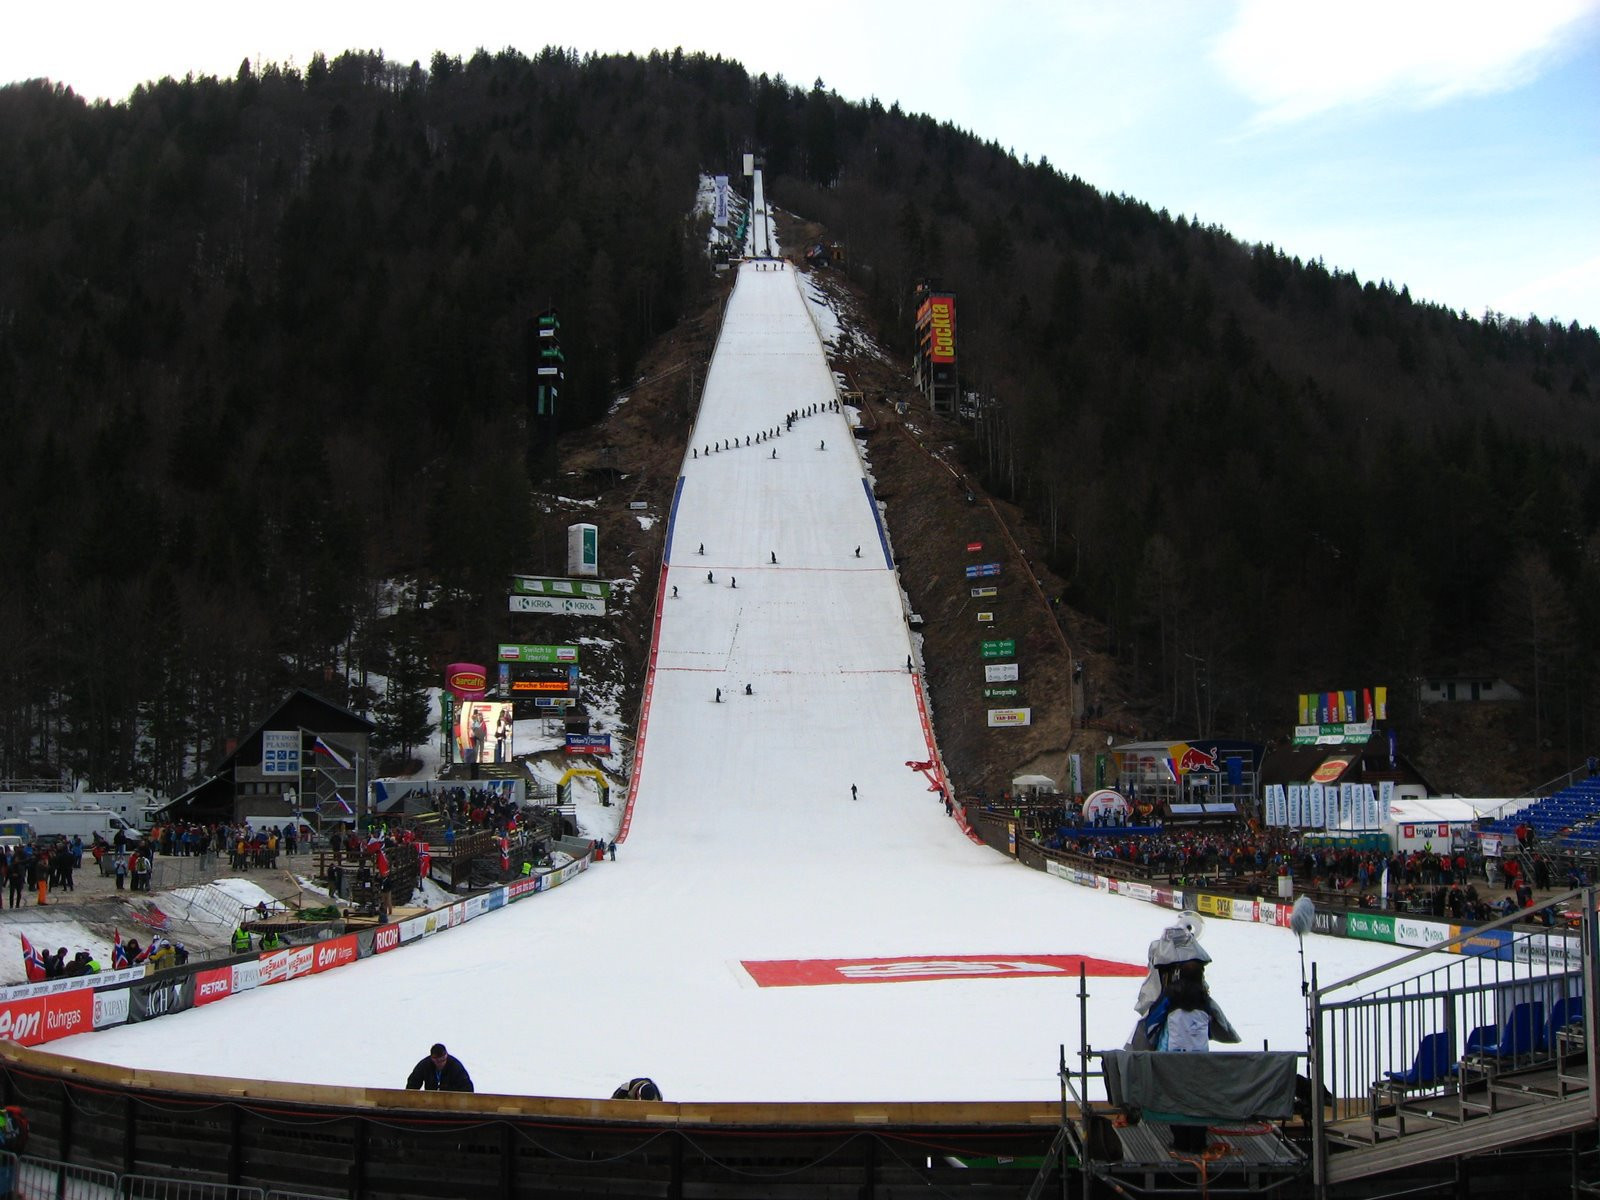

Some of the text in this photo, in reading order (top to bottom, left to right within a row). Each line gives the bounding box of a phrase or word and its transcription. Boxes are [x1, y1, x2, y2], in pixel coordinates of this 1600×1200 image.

[931, 303, 955, 357] Cockta
[531, 599, 553, 609] KRKA
[574, 602, 597, 611] KRKA
[1216, 898, 1231, 913] SVEA
[376, 927, 399, 950] RICOH
[200, 979, 228, 996] PETROL
[145, 987, 168, 1017] ACH
[47, 1008, 81, 1030] Ruhrgas
